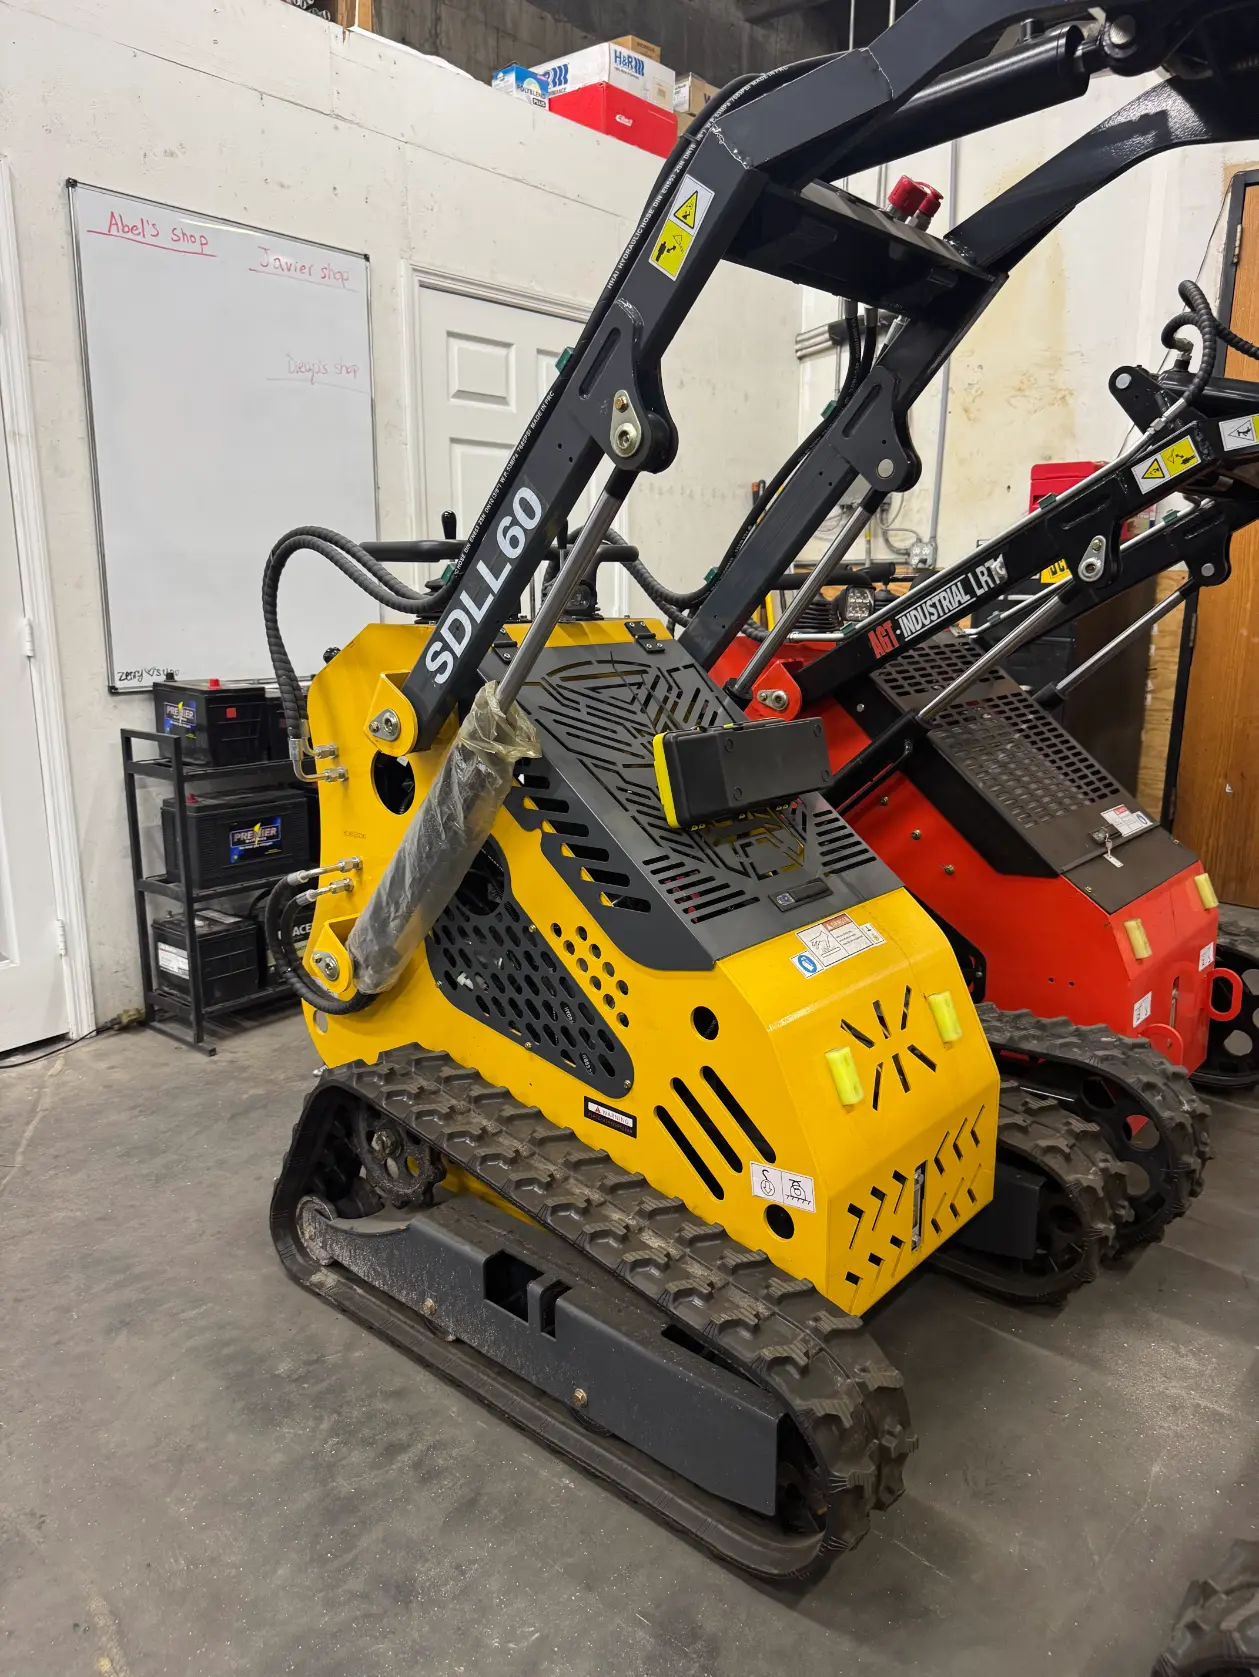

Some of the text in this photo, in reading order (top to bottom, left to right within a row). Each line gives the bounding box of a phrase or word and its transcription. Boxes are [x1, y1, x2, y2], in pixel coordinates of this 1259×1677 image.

[107, 210, 160, 239] Abel's
[618, 227, 643, 269] HYDRAULIC
[641, 209, 654, 229] HOSE
[653, 195, 663, 207] DIN
[257, 245, 313, 277] Javier
[530, 411, 544, 430] MADE
[867, 620, 899, 660] AGT
[602, 1110, 629, 1125] WARNING
